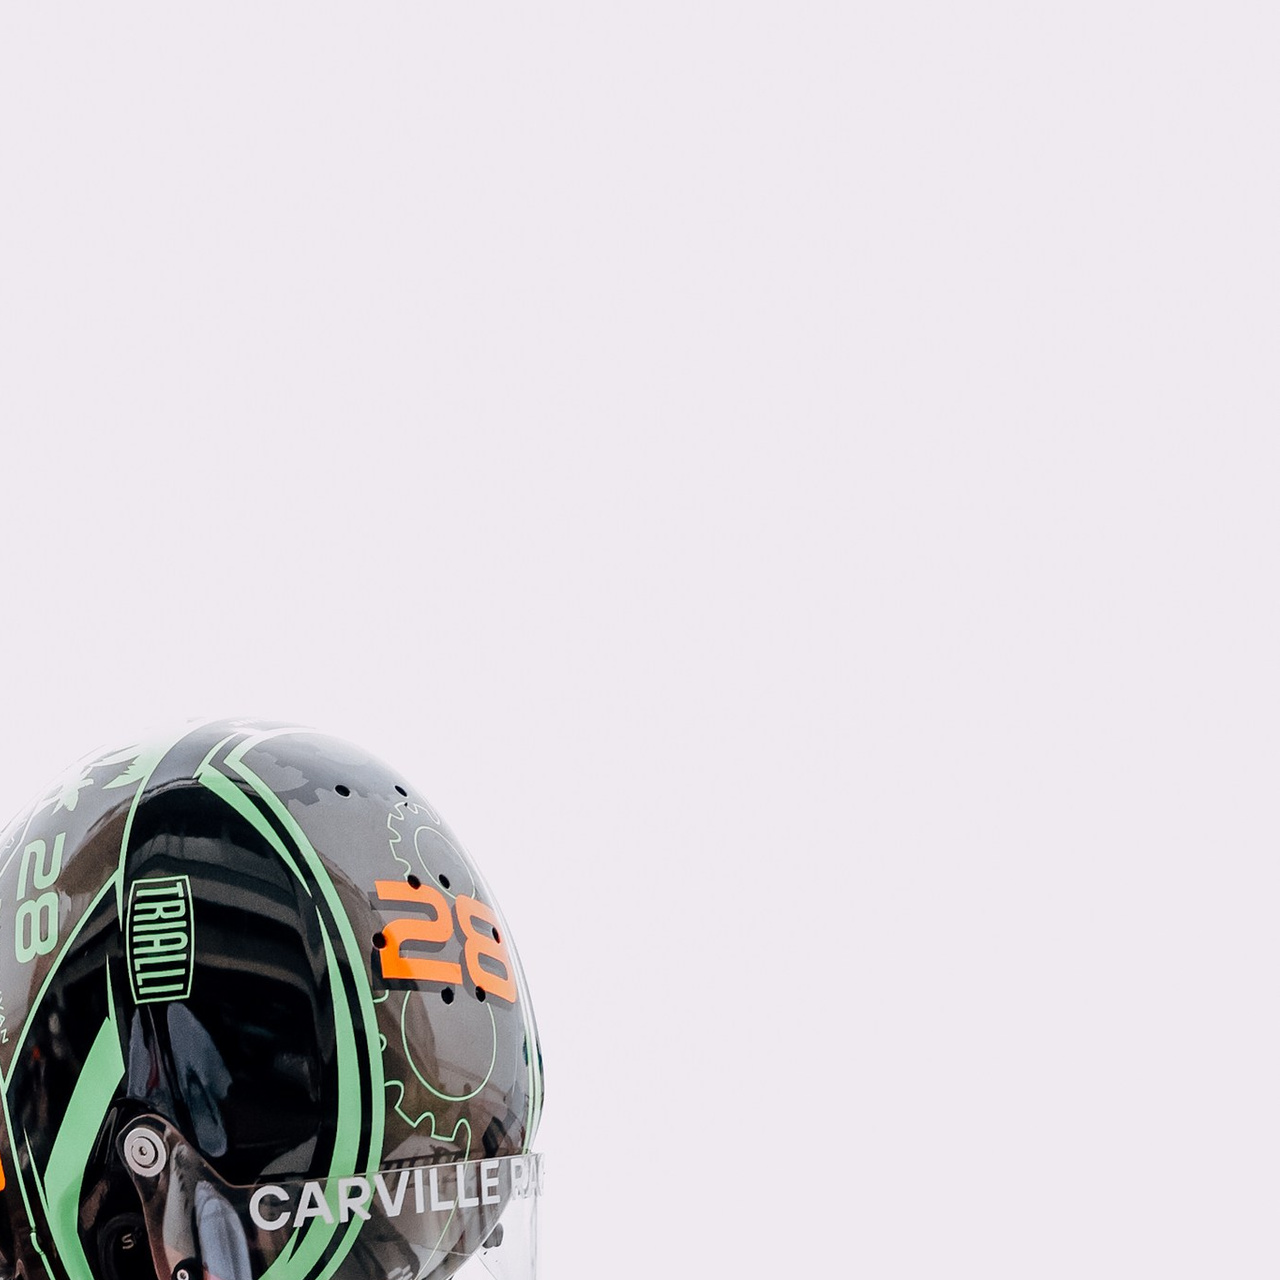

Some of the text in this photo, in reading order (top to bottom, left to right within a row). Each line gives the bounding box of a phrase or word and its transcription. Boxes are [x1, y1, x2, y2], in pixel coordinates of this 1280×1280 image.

[15, 832, 66, 963] 28
[133, 882, 188, 994] TRIALLI
[374, 878, 518, 1004] 28
[249, 1159, 502, 1231] CARVILLE
